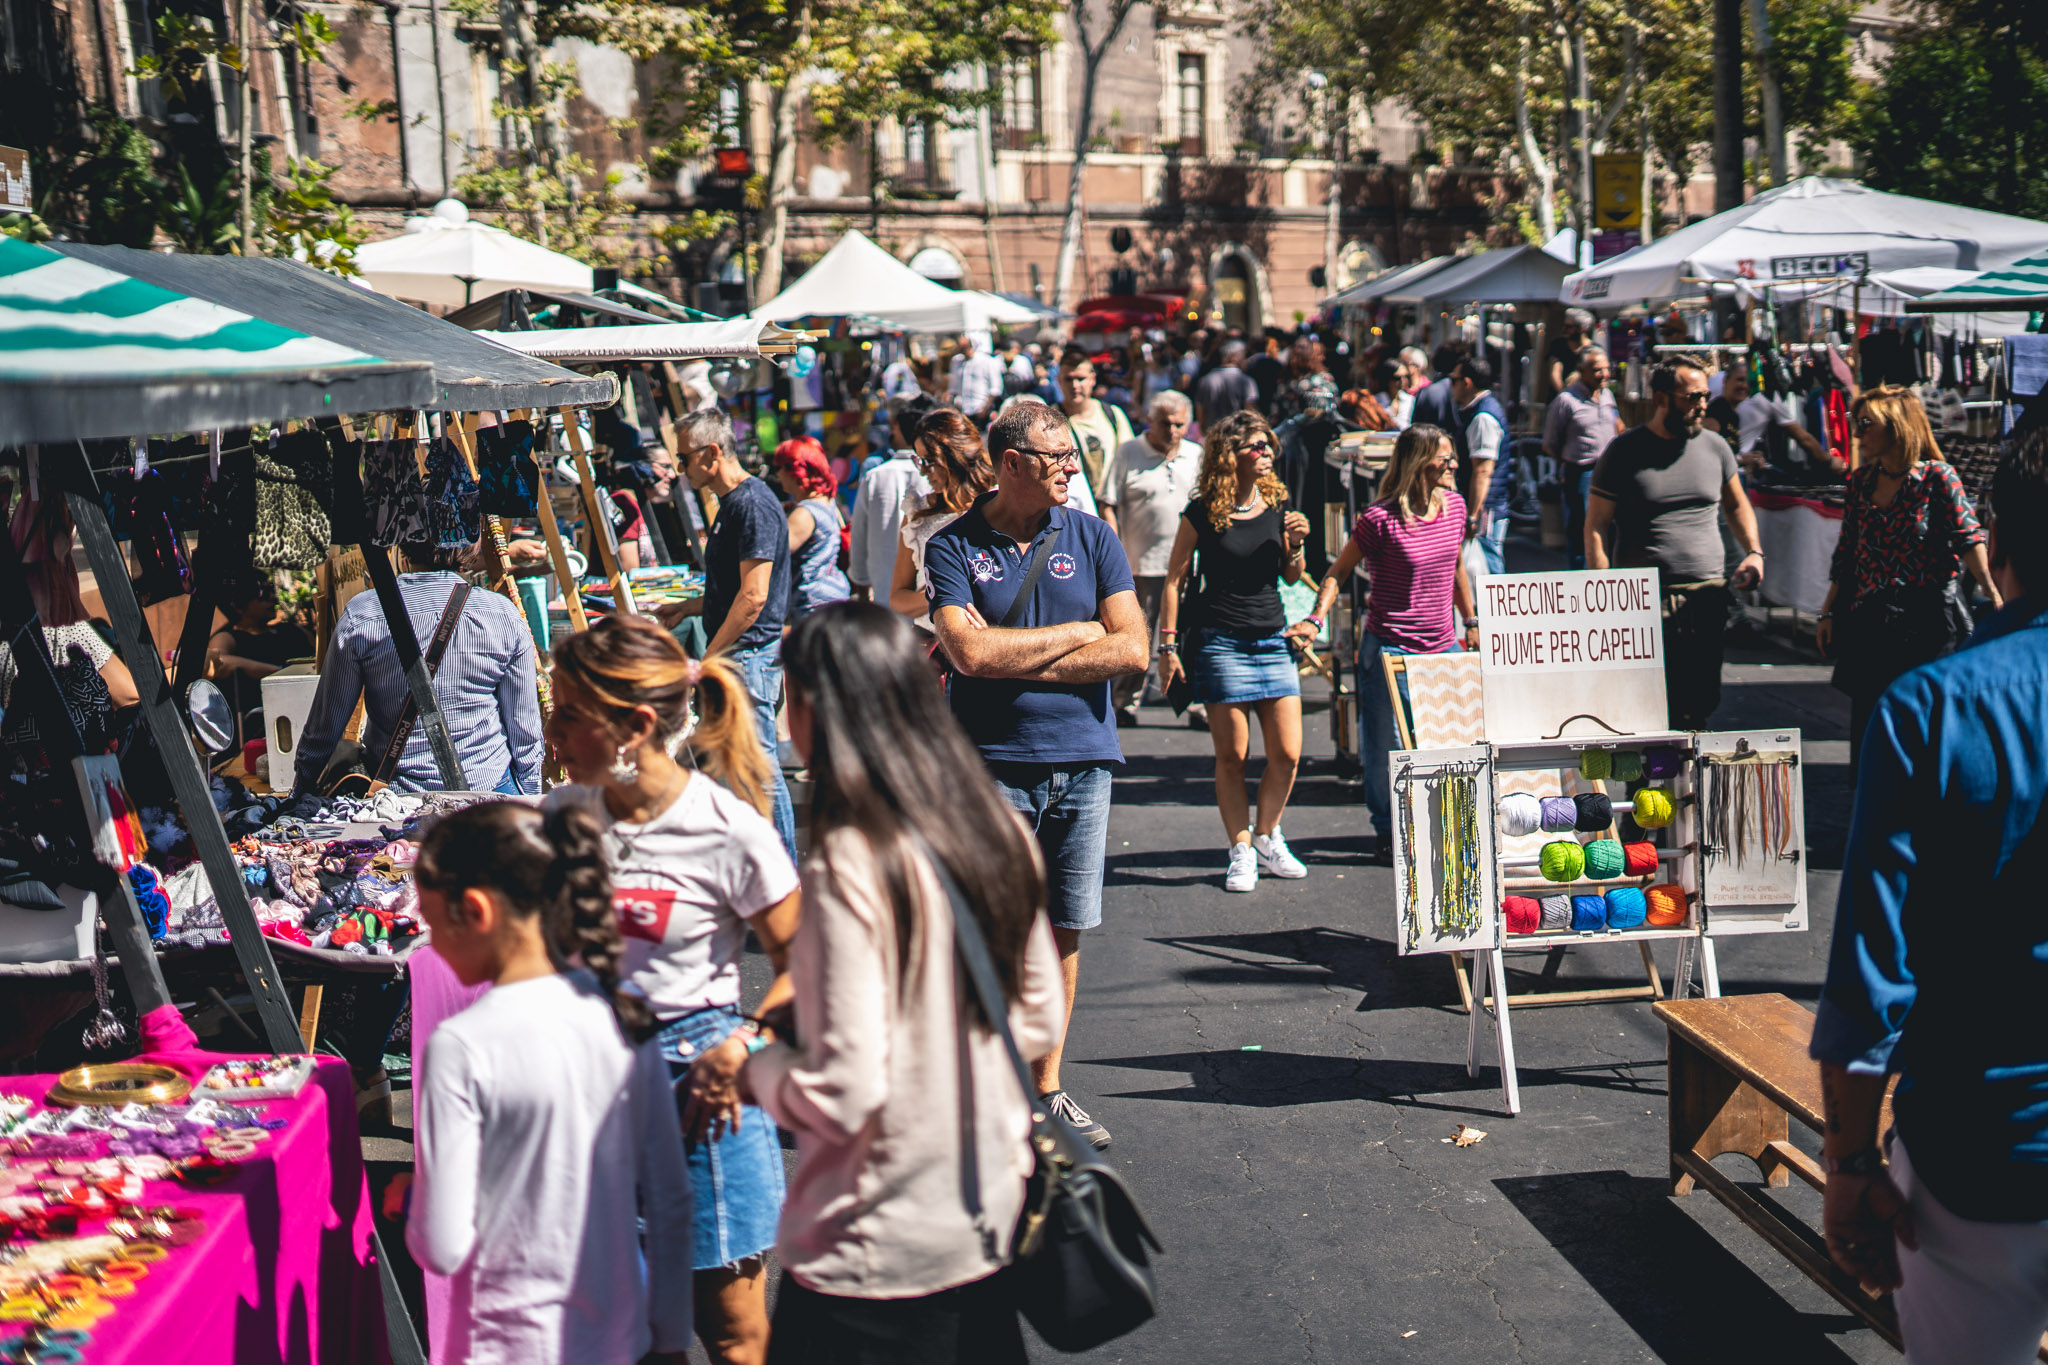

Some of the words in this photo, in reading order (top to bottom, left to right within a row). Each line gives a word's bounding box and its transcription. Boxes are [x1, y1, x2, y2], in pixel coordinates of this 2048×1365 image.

[1486, 581, 1566, 617] TRECCINE
[1570, 595, 1580, 613] DI
[1584, 578, 1651, 613] COTONE
[438, 605, 459, 642] POLLINI
[1491, 631, 1544, 666] PIUME
[1550, 630, 1583, 663] PER
[1587, 627, 1655, 662] CAPELLI
[389, 720, 411, 758] POLLINI
